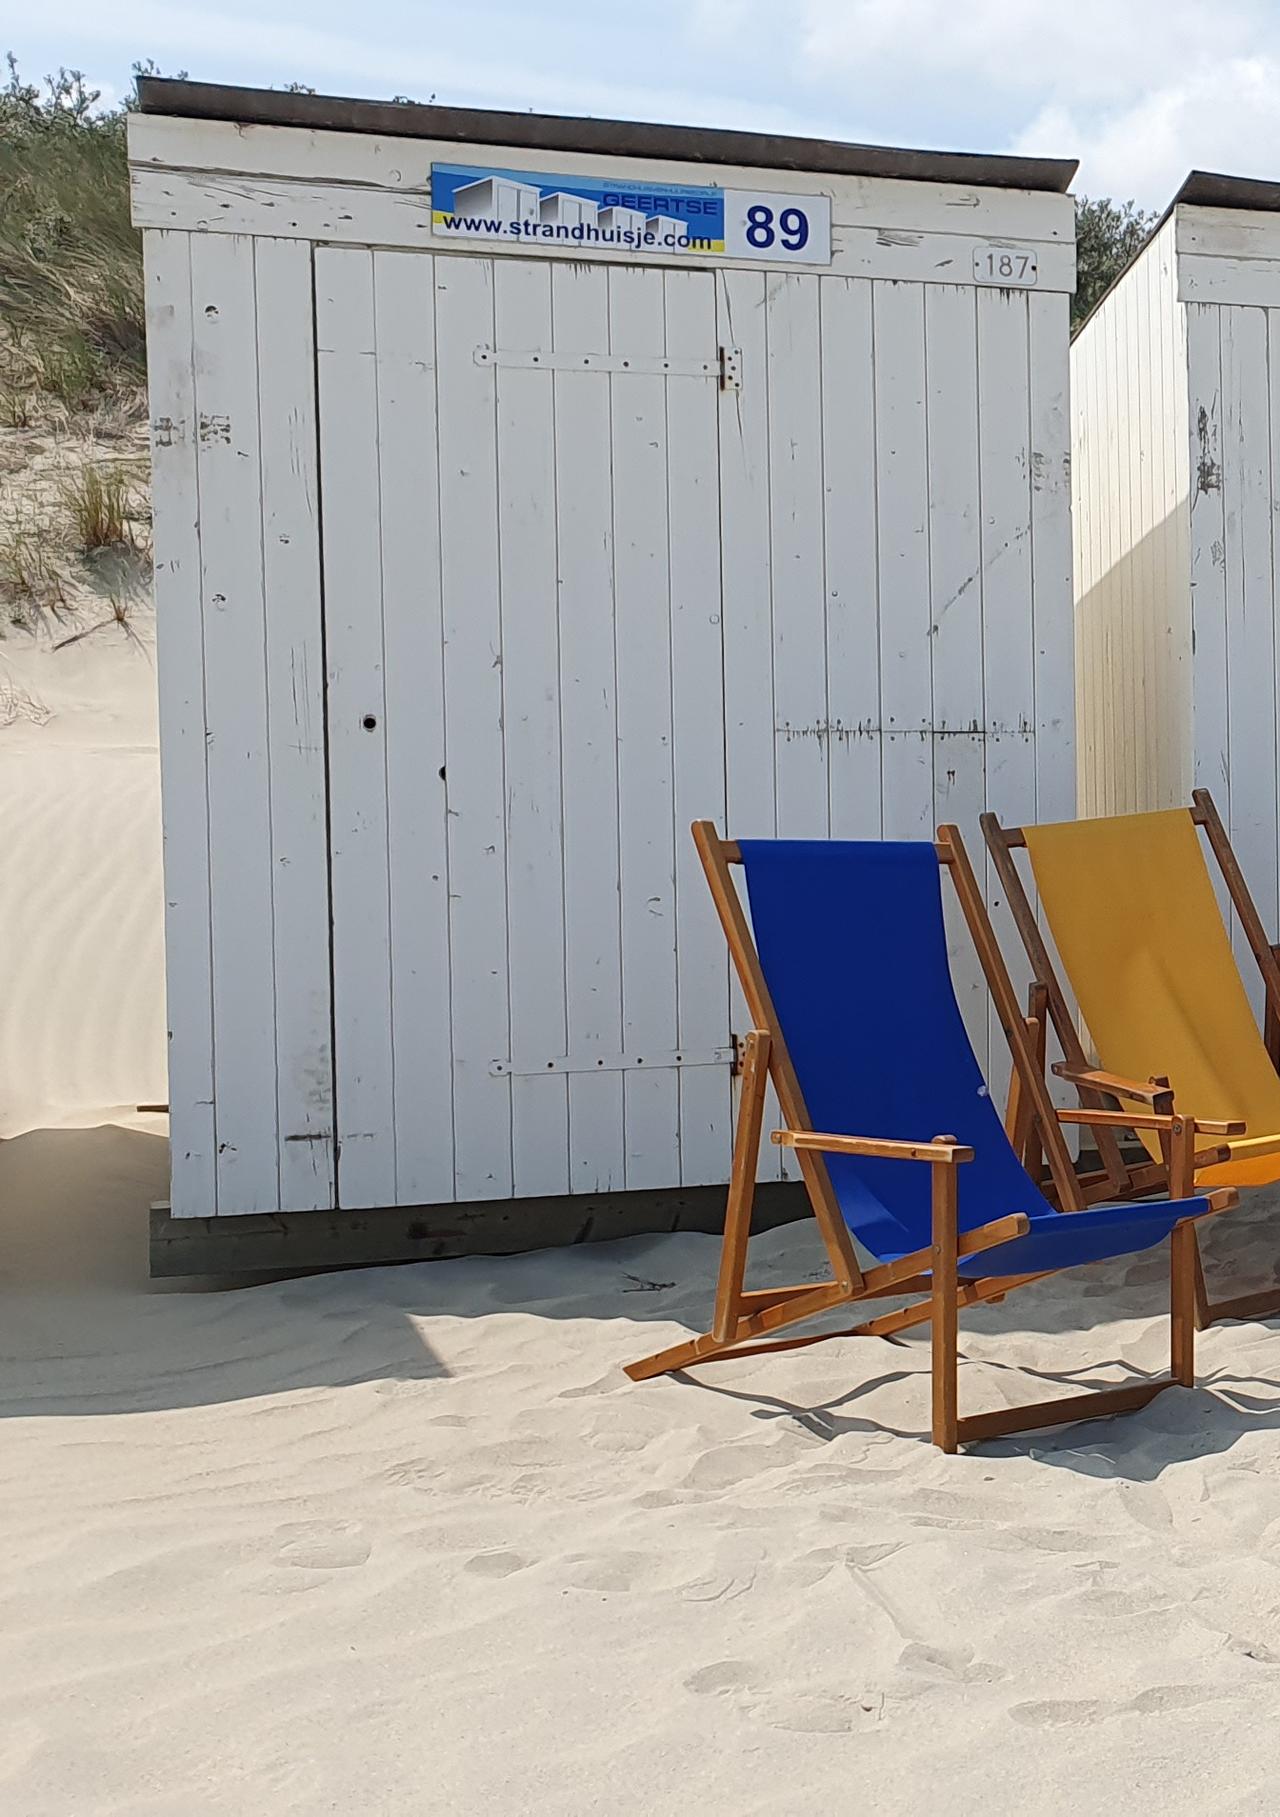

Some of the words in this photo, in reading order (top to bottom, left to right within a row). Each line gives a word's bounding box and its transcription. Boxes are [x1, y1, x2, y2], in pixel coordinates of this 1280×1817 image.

[602, 193, 719, 216] GEERTSE
[443, 214, 712, 250] www.strandhuisje.com
[746, 205, 809, 251] 89
[985, 253, 1030, 279] 187
